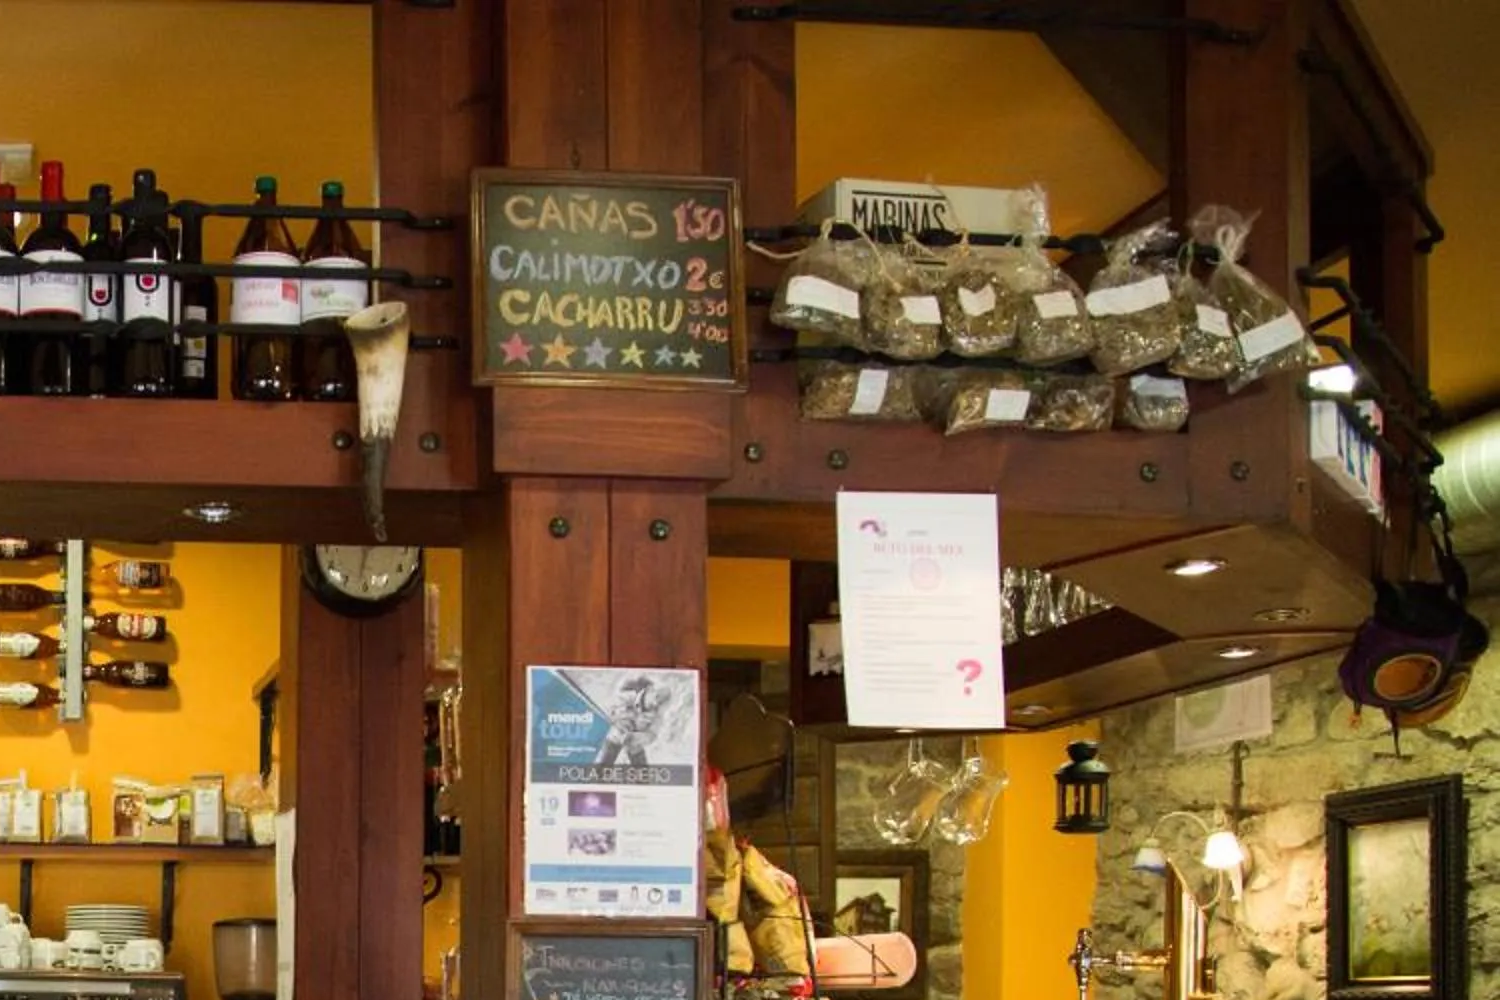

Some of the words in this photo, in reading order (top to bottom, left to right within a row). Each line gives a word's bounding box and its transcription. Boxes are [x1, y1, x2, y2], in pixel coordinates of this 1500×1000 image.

[504, 194, 658, 239] CAÑAS
[490, 240, 681, 290] CALIMOTXO
[500, 289, 684, 334] CACHARRU
[540, 719, 589, 740] tour
[559, 766, 599, 782] POLA
[602, 766, 623, 782] DE
